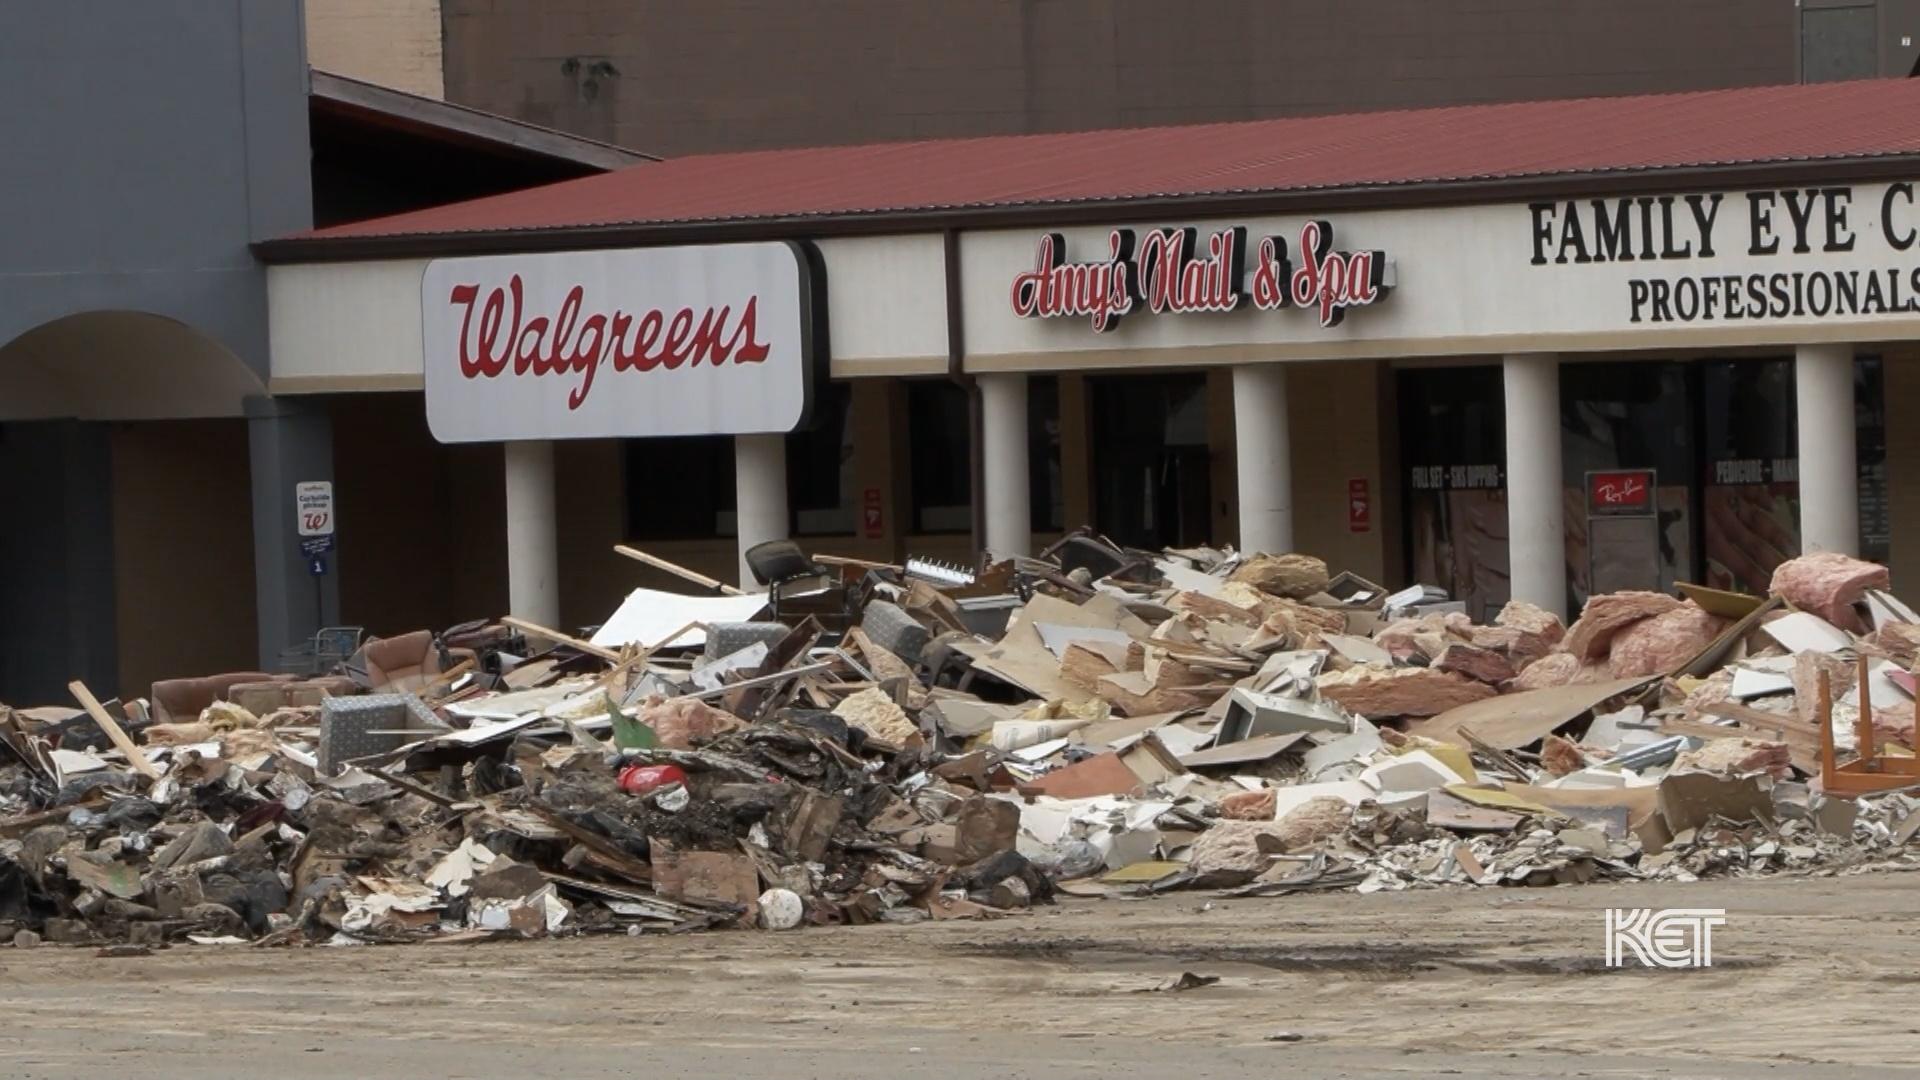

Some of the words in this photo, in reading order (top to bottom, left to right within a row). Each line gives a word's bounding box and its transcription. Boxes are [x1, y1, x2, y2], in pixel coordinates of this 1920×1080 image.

[1528, 193, 1724, 266] FAMILY
[1745, 186, 1857, 256] EYE
[1880, 182, 1920, 251] C
[1010, 229, 1135, 332] Amy's
[1137, 226, 1238, 315] Nail
[1252, 236, 1286, 311] &
[1290, 220, 1379, 327] Spa
[450, 273, 771, 411] Walgreens
[314, 561, 323, 573] 1
